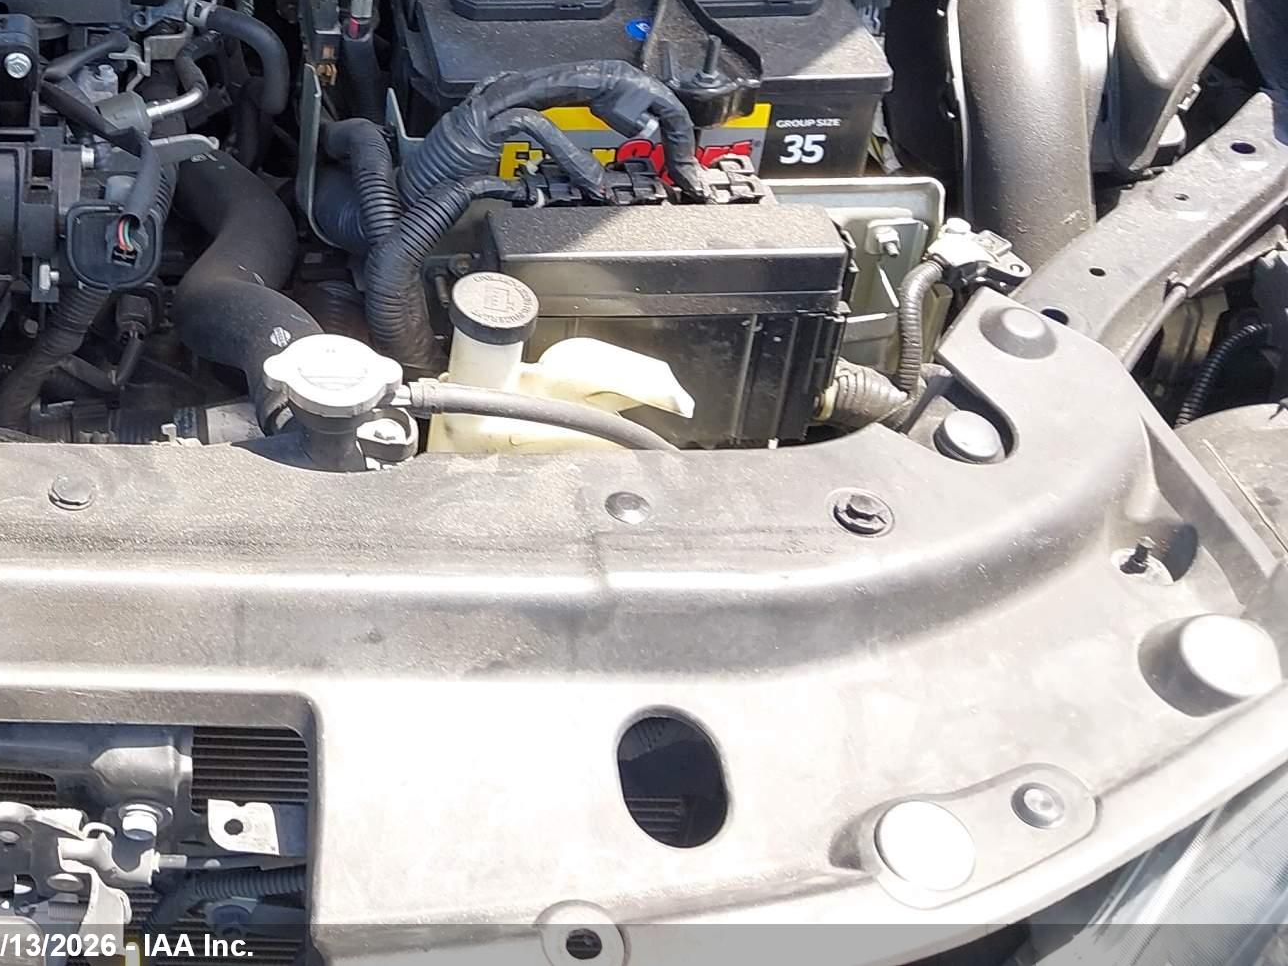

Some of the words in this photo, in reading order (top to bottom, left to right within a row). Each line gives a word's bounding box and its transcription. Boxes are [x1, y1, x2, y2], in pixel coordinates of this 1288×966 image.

[776, 119, 815, 128] GROUP
[816, 118, 841, 127] SIZE
[499, 138, 754, 185] ErStrt
[779, 134, 827, 164] 35
